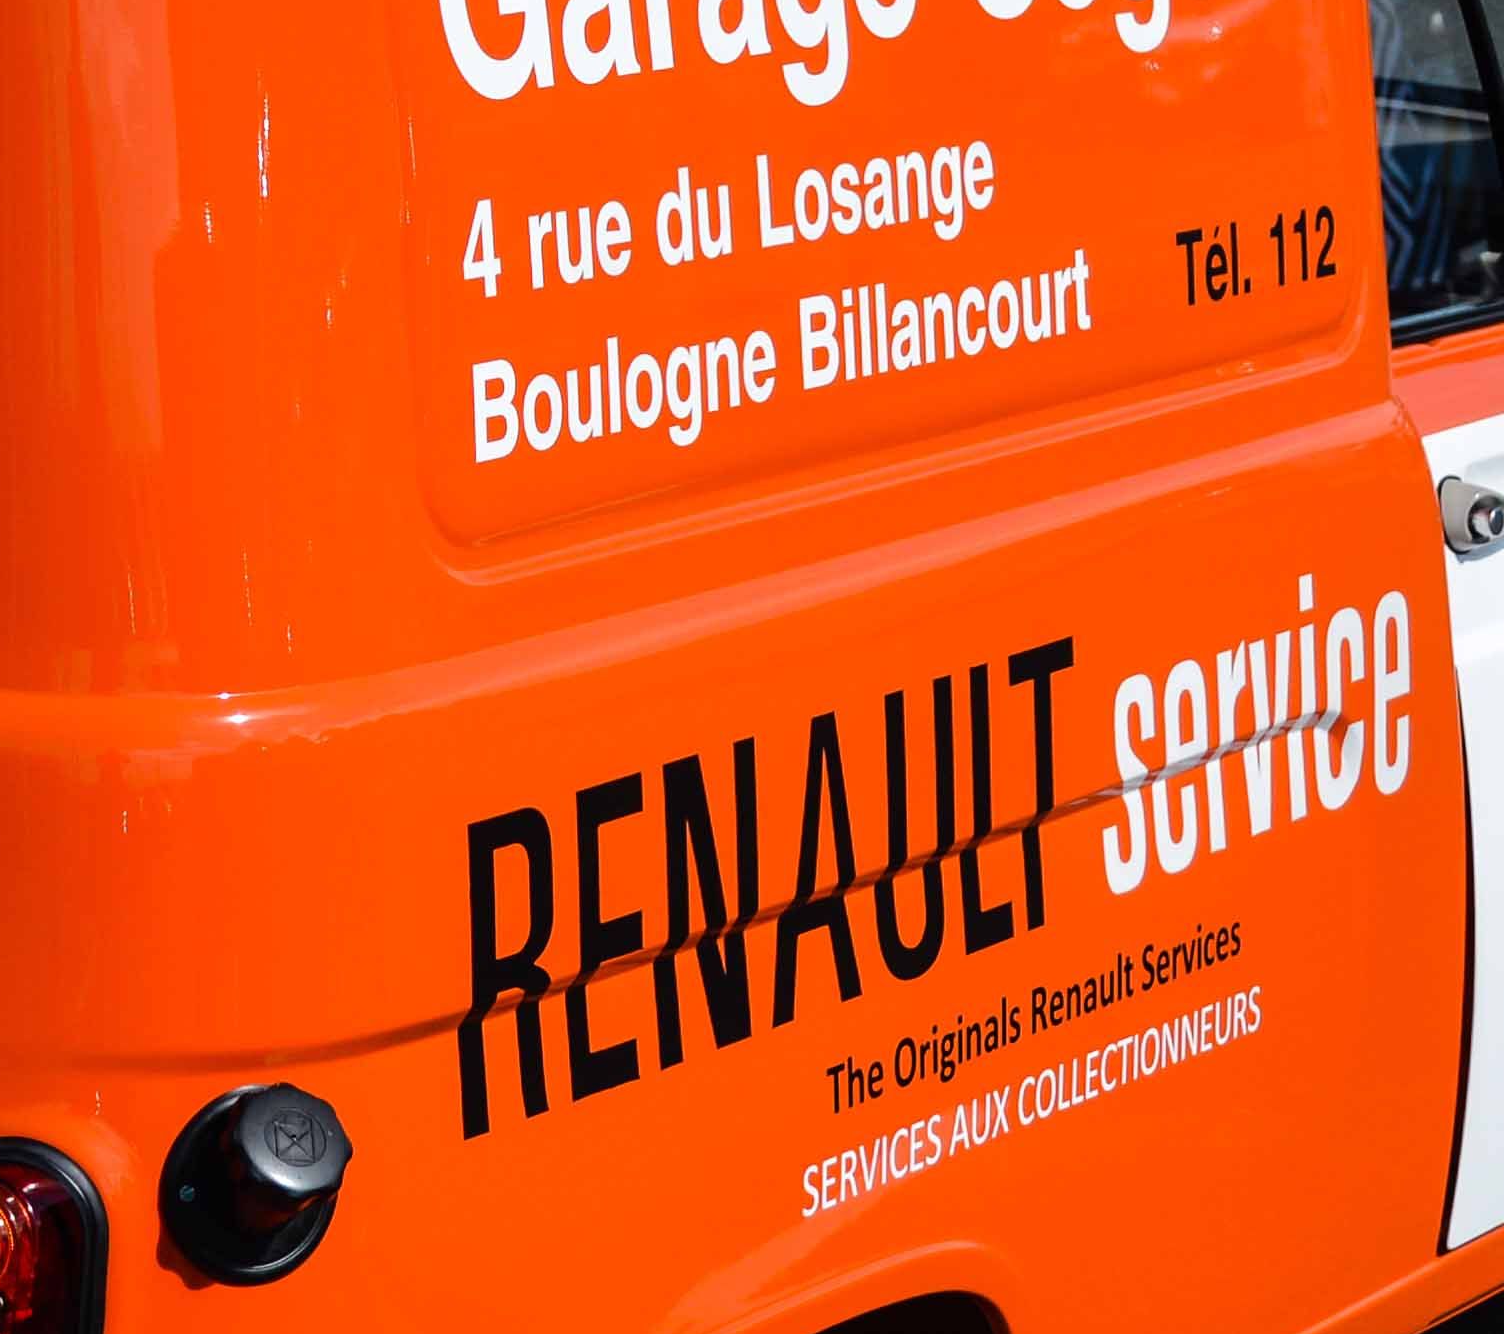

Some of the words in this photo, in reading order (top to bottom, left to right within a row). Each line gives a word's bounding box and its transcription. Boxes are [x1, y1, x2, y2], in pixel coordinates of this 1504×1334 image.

[462, 198, 502, 299] 4
[527, 199, 633, 291] rue
[655, 167, 734, 263] du
[756, 140, 995, 247] Losange
[1175, 222, 1253, 306] Tél.
[1268, 204, 1337, 288] 112
[471, 328, 777, 464] Boulogne
[799, 248, 1092, 390] Billancourt
[457, 635, 1074, 1141] RENAULT
[1102, 573, 1412, 897] service
[801, 1114, 942, 1219] SERVICES
[949, 1084, 1011, 1155] AUX
[1017, 984, 1263, 1125] COLLECTIONNEURS
[826, 1059, 885, 1115] The
[892, 994, 1023, 1089] Originals
[1029, 952, 1134, 1036] Renault
[1140, 919, 1243, 990] Services
